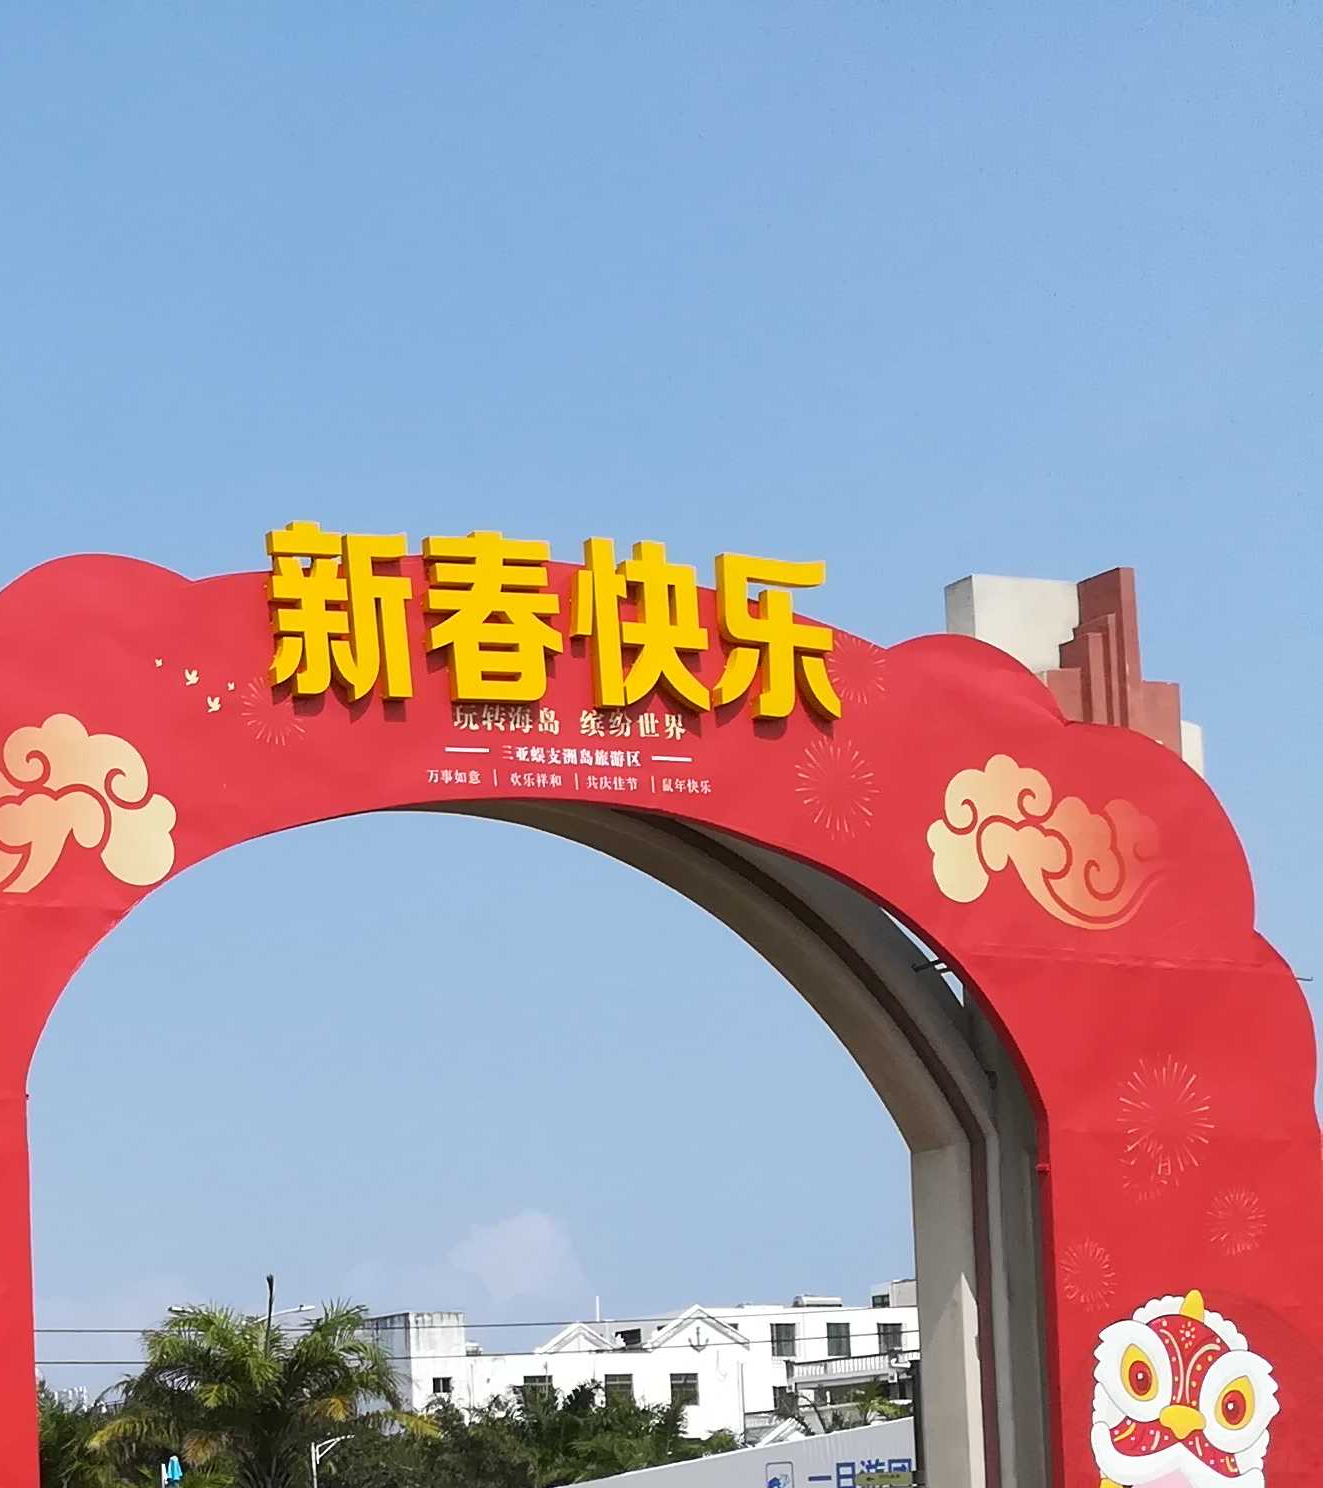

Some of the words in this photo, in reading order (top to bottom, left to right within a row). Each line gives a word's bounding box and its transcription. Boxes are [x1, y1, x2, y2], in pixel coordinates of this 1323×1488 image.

[265, 520, 842, 720] 新春快乐
[453, 704, 560, 735] 玩转海岛
[579, 708, 687, 741] 缤纷世界
[426, 769, 482, 785] 万事如意
[510, 772, 563, 788] 欢乐祥和
[661, 778, 712, 795] 鼠年快乐
